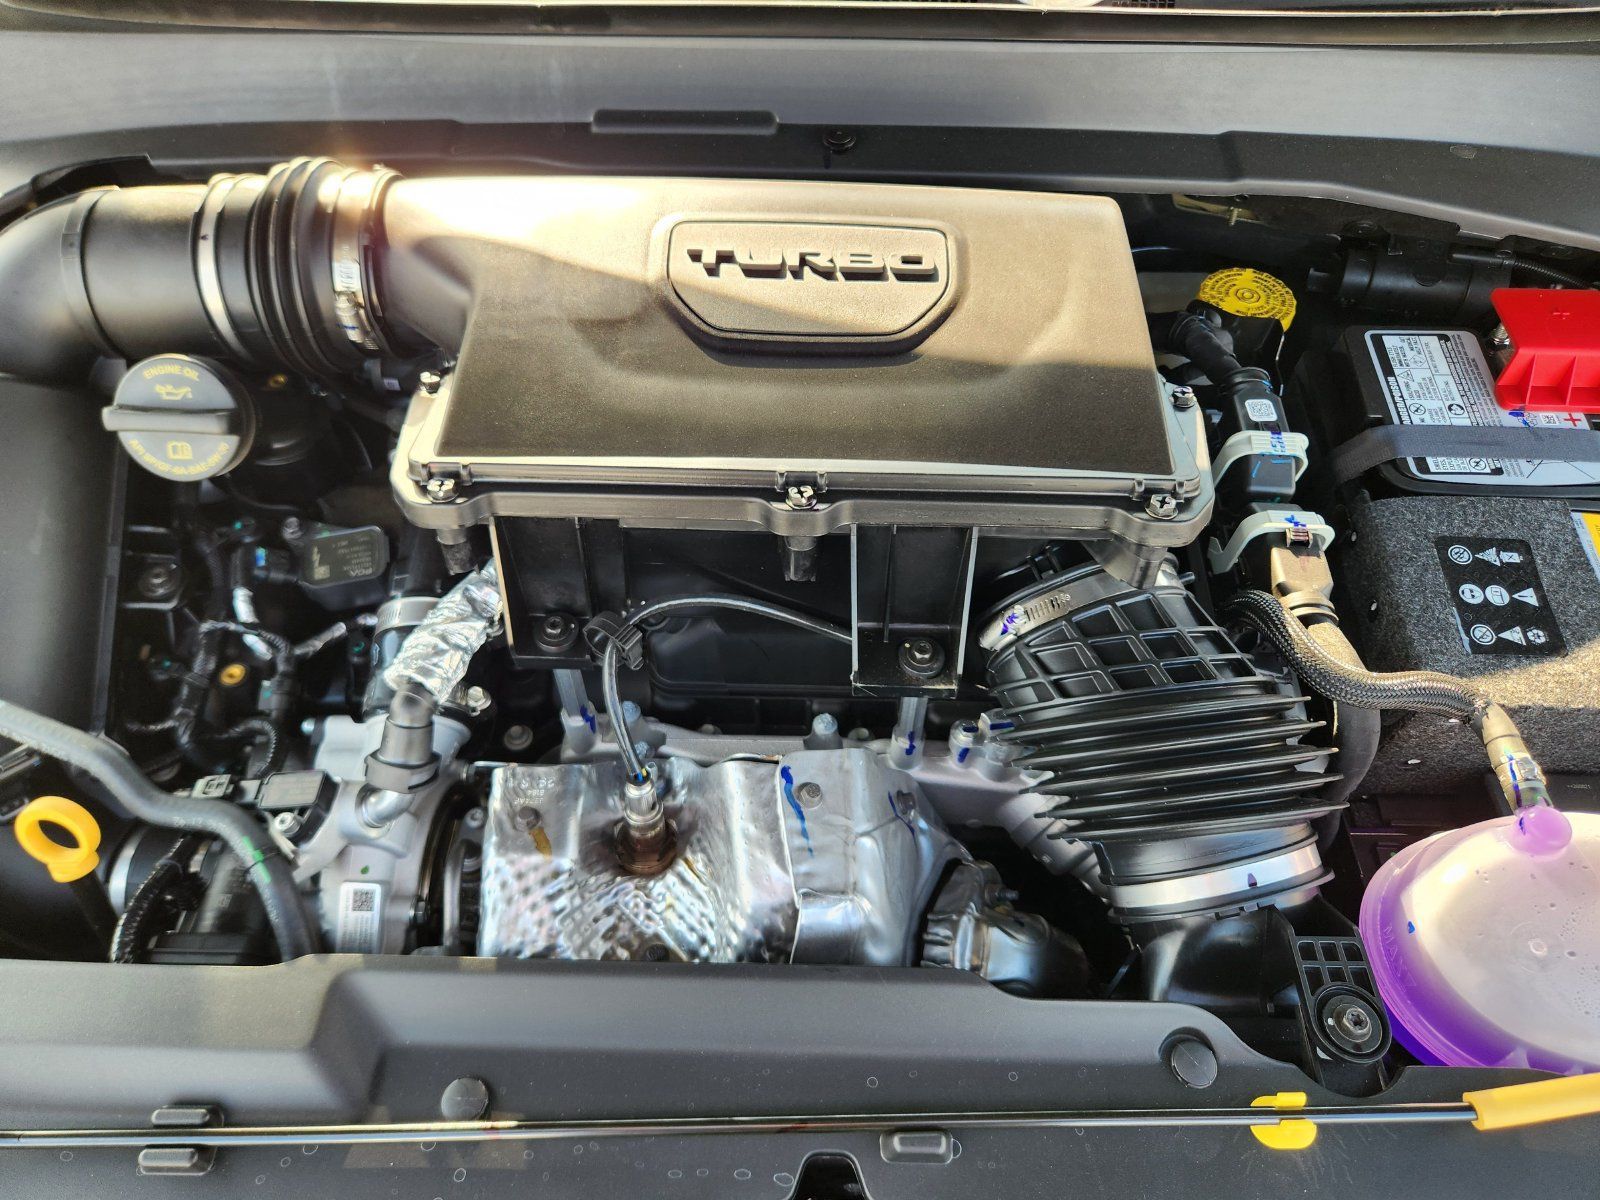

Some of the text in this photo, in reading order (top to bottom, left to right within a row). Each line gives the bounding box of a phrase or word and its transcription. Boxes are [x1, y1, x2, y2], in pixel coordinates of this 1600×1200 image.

[686, 247, 940, 282] TURBO
[143, 363, 200, 382] ENGINE OIL
